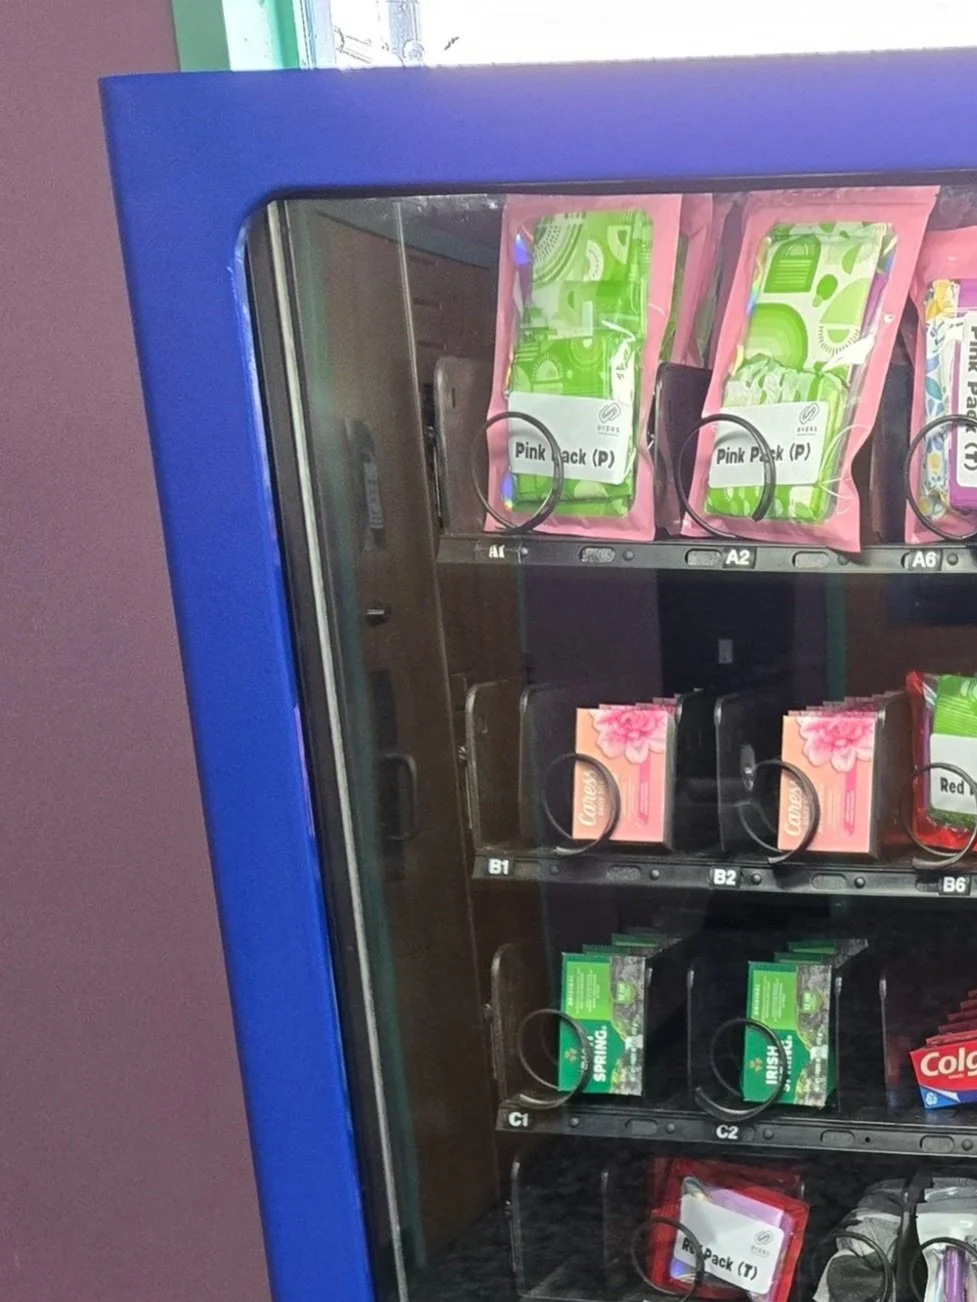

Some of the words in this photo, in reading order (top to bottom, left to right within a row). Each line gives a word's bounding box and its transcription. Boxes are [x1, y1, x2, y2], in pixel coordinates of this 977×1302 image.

[515, 441, 546, 462] Pink
[551, 448, 587, 466] ack
[592, 448, 615, 469] (P)
[716, 446, 746, 465] Pink
[789, 442, 811, 462] (P)
[725, 549, 750, 566] A2
[911, 552, 937, 568] A6
[939, 776, 965, 795] Red
[488, 859, 509, 875] B1
[713, 869, 737, 886] B2
[942, 877, 966, 893] B6
[593, 1030, 608, 1082] SPRING
[765, 1045, 779, 1085] IRISH
[509, 1111, 529, 1127] C1
[715, 1124, 739, 1140] C2
[703, 1247, 734, 1272] Pack
[737, 1260, 758, 1281] (T)
